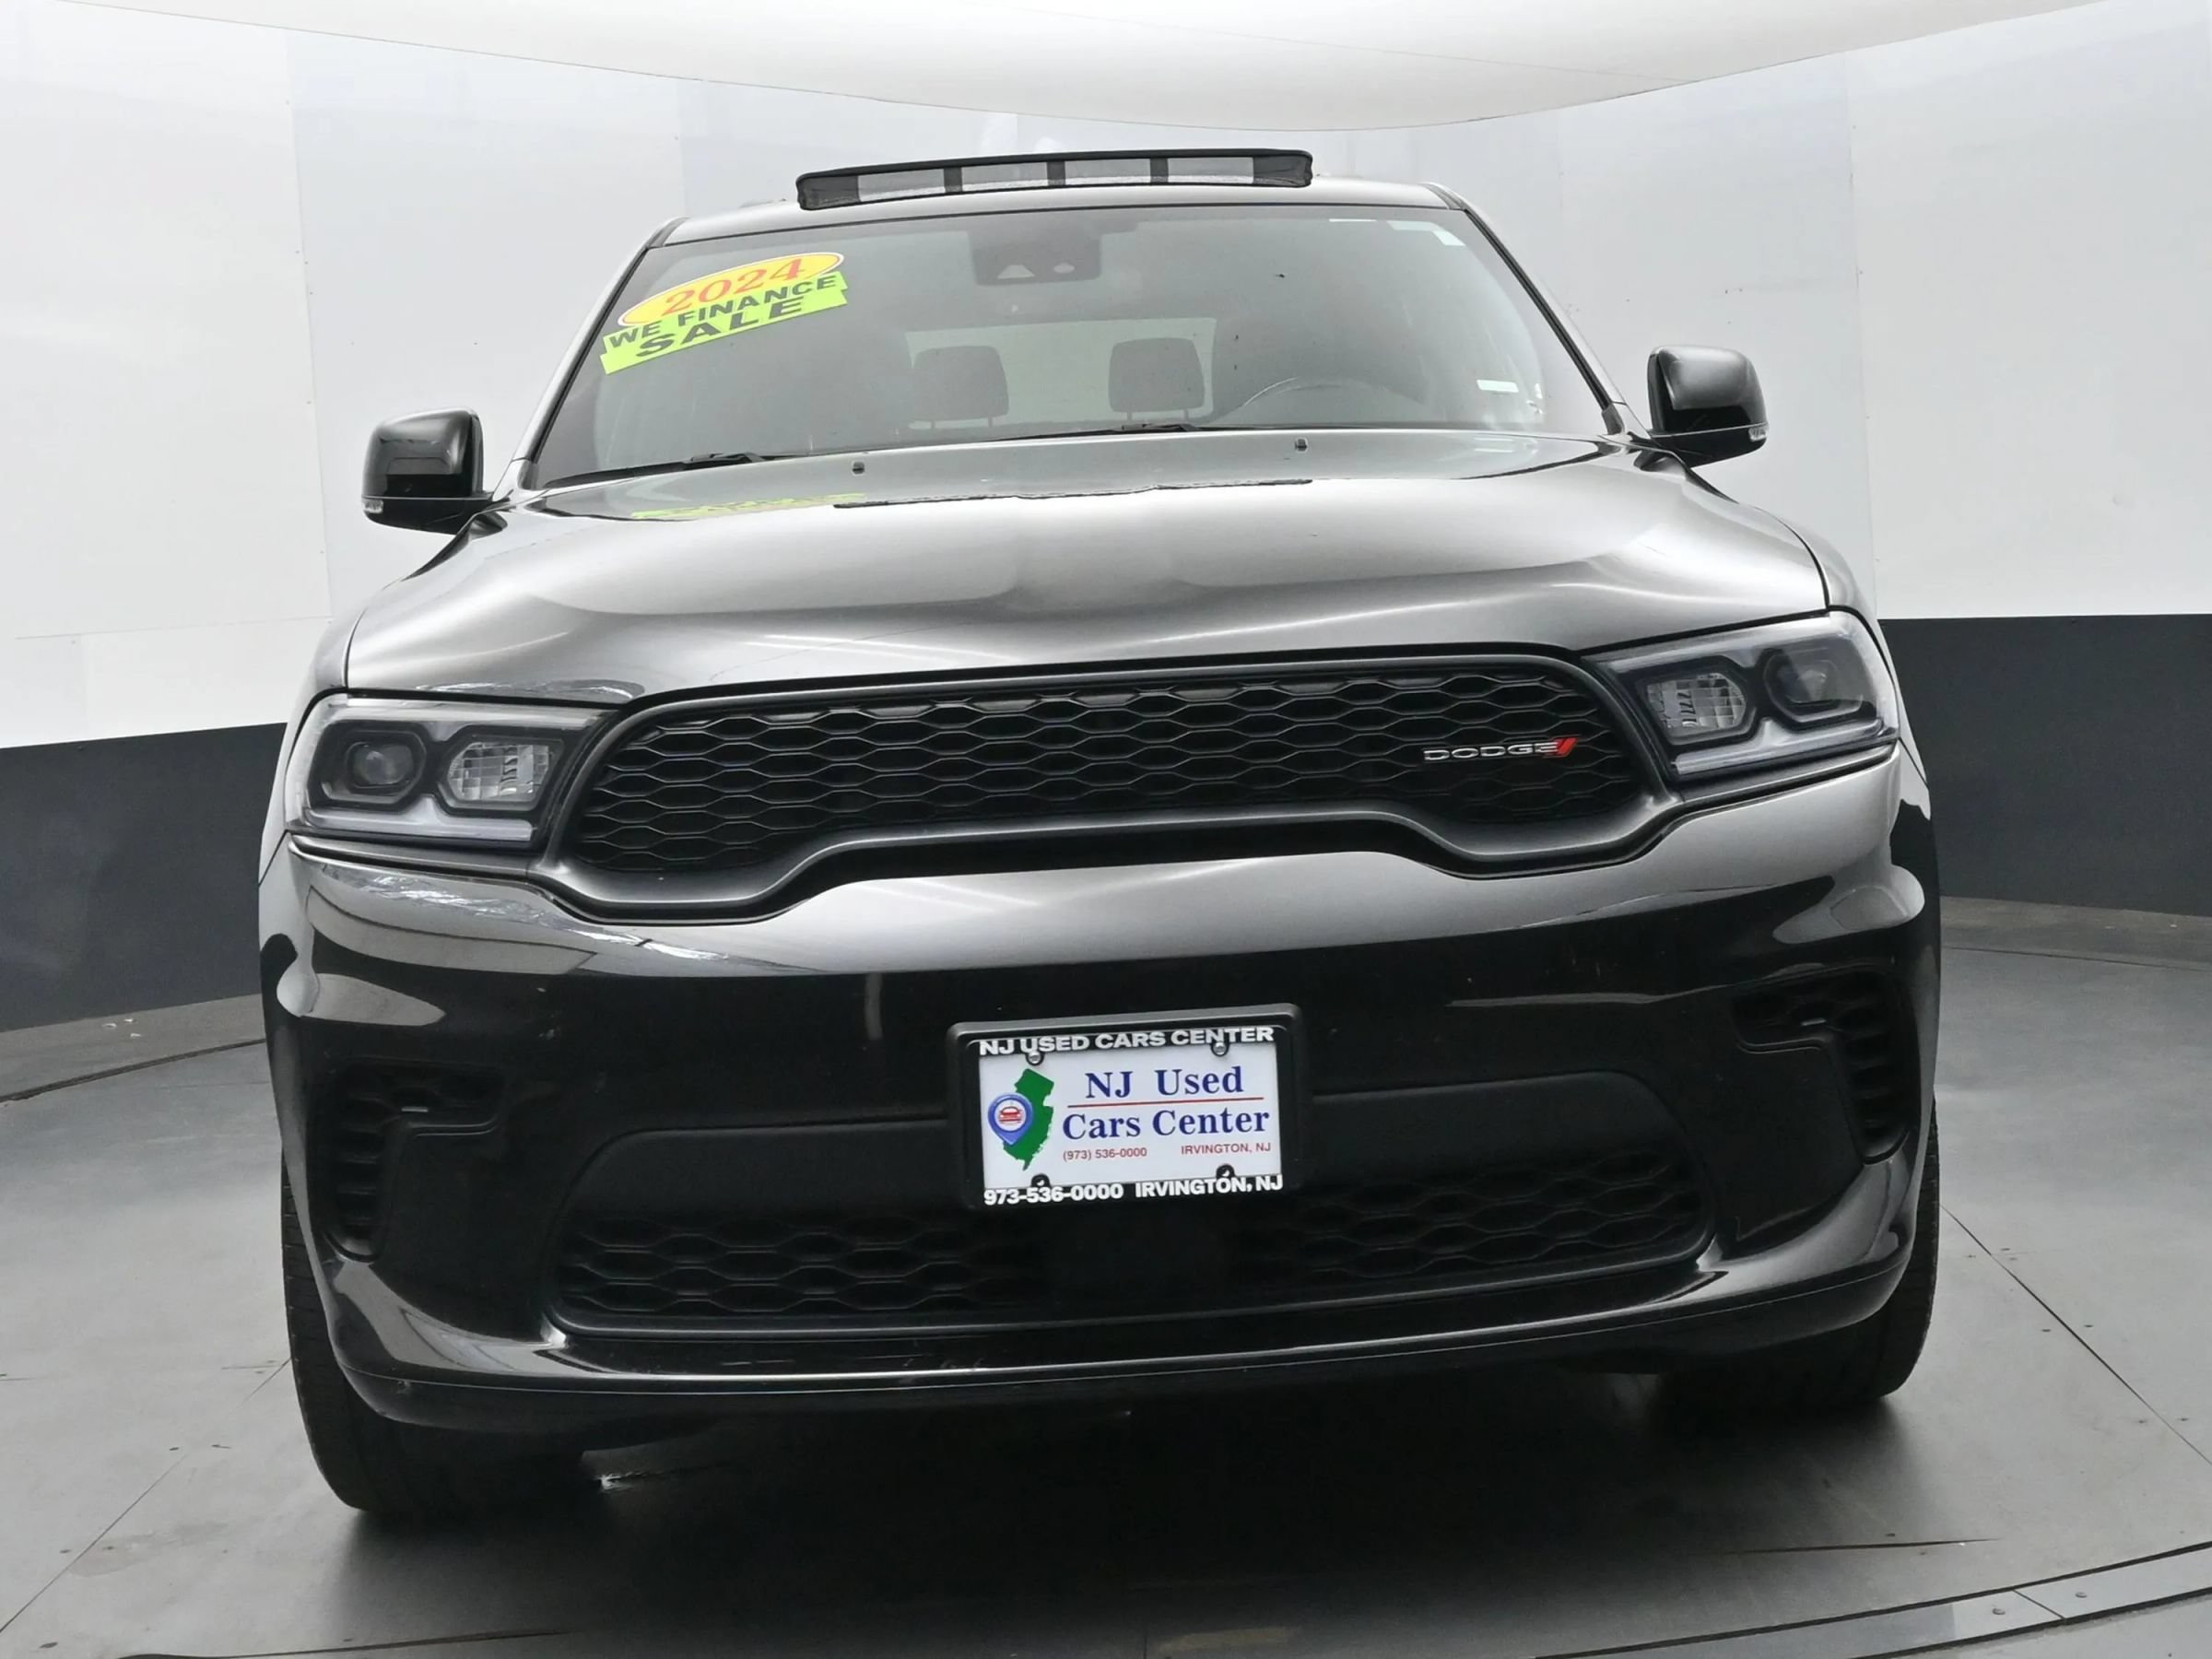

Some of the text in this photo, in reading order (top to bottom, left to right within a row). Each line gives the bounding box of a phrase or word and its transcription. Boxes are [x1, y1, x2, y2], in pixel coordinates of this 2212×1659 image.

[661, 257, 806, 316] 2024
[608, 275, 837, 348] WE FINANCE
[636, 296, 805, 358] SALE
[1423, 741, 1559, 761] DODGE
[979, 1026, 1275, 1056] NJ USED CARS CENTER
[1084, 1065, 1244, 1099] NJ Used
[1062, 1107, 1270, 1140] Cars Center
[1062, 1147, 1147, 1162] (973) 536-0000
[1181, 1142, 1272, 1155] IRVINGTON, NJ
[983, 1174, 1284, 1206] 973-536-0000 IRVINGTON, NJ
